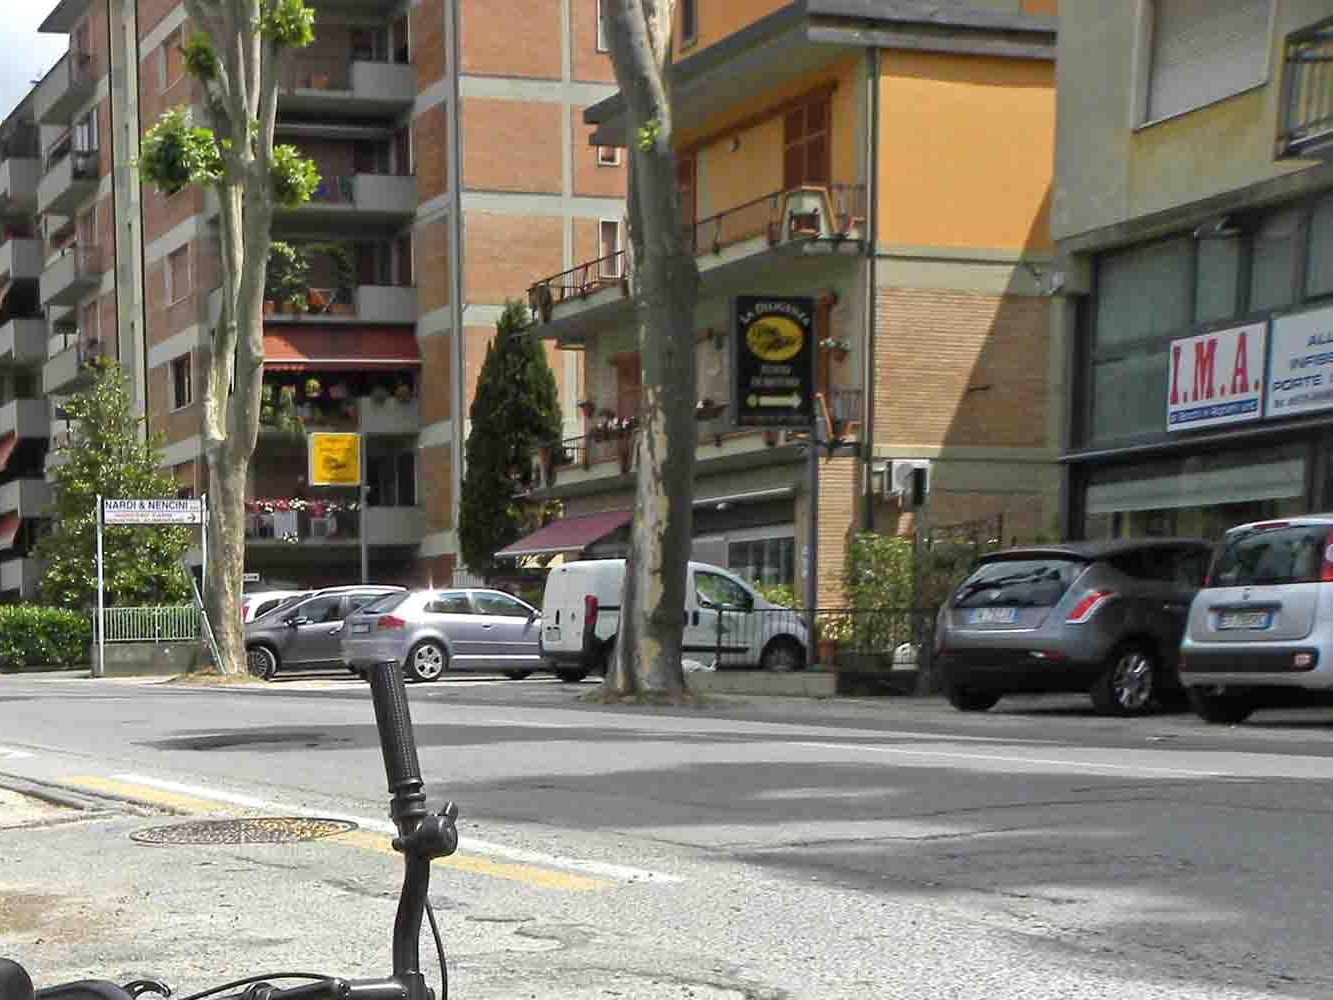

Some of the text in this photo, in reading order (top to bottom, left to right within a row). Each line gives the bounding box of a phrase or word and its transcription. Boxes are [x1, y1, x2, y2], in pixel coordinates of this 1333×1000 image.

[1170, 332, 1261, 405] I.M.A.
[106, 501, 136, 510] NARDI
[139, 501, 145, 510] &
[148, 501, 187, 510] NENCINI
